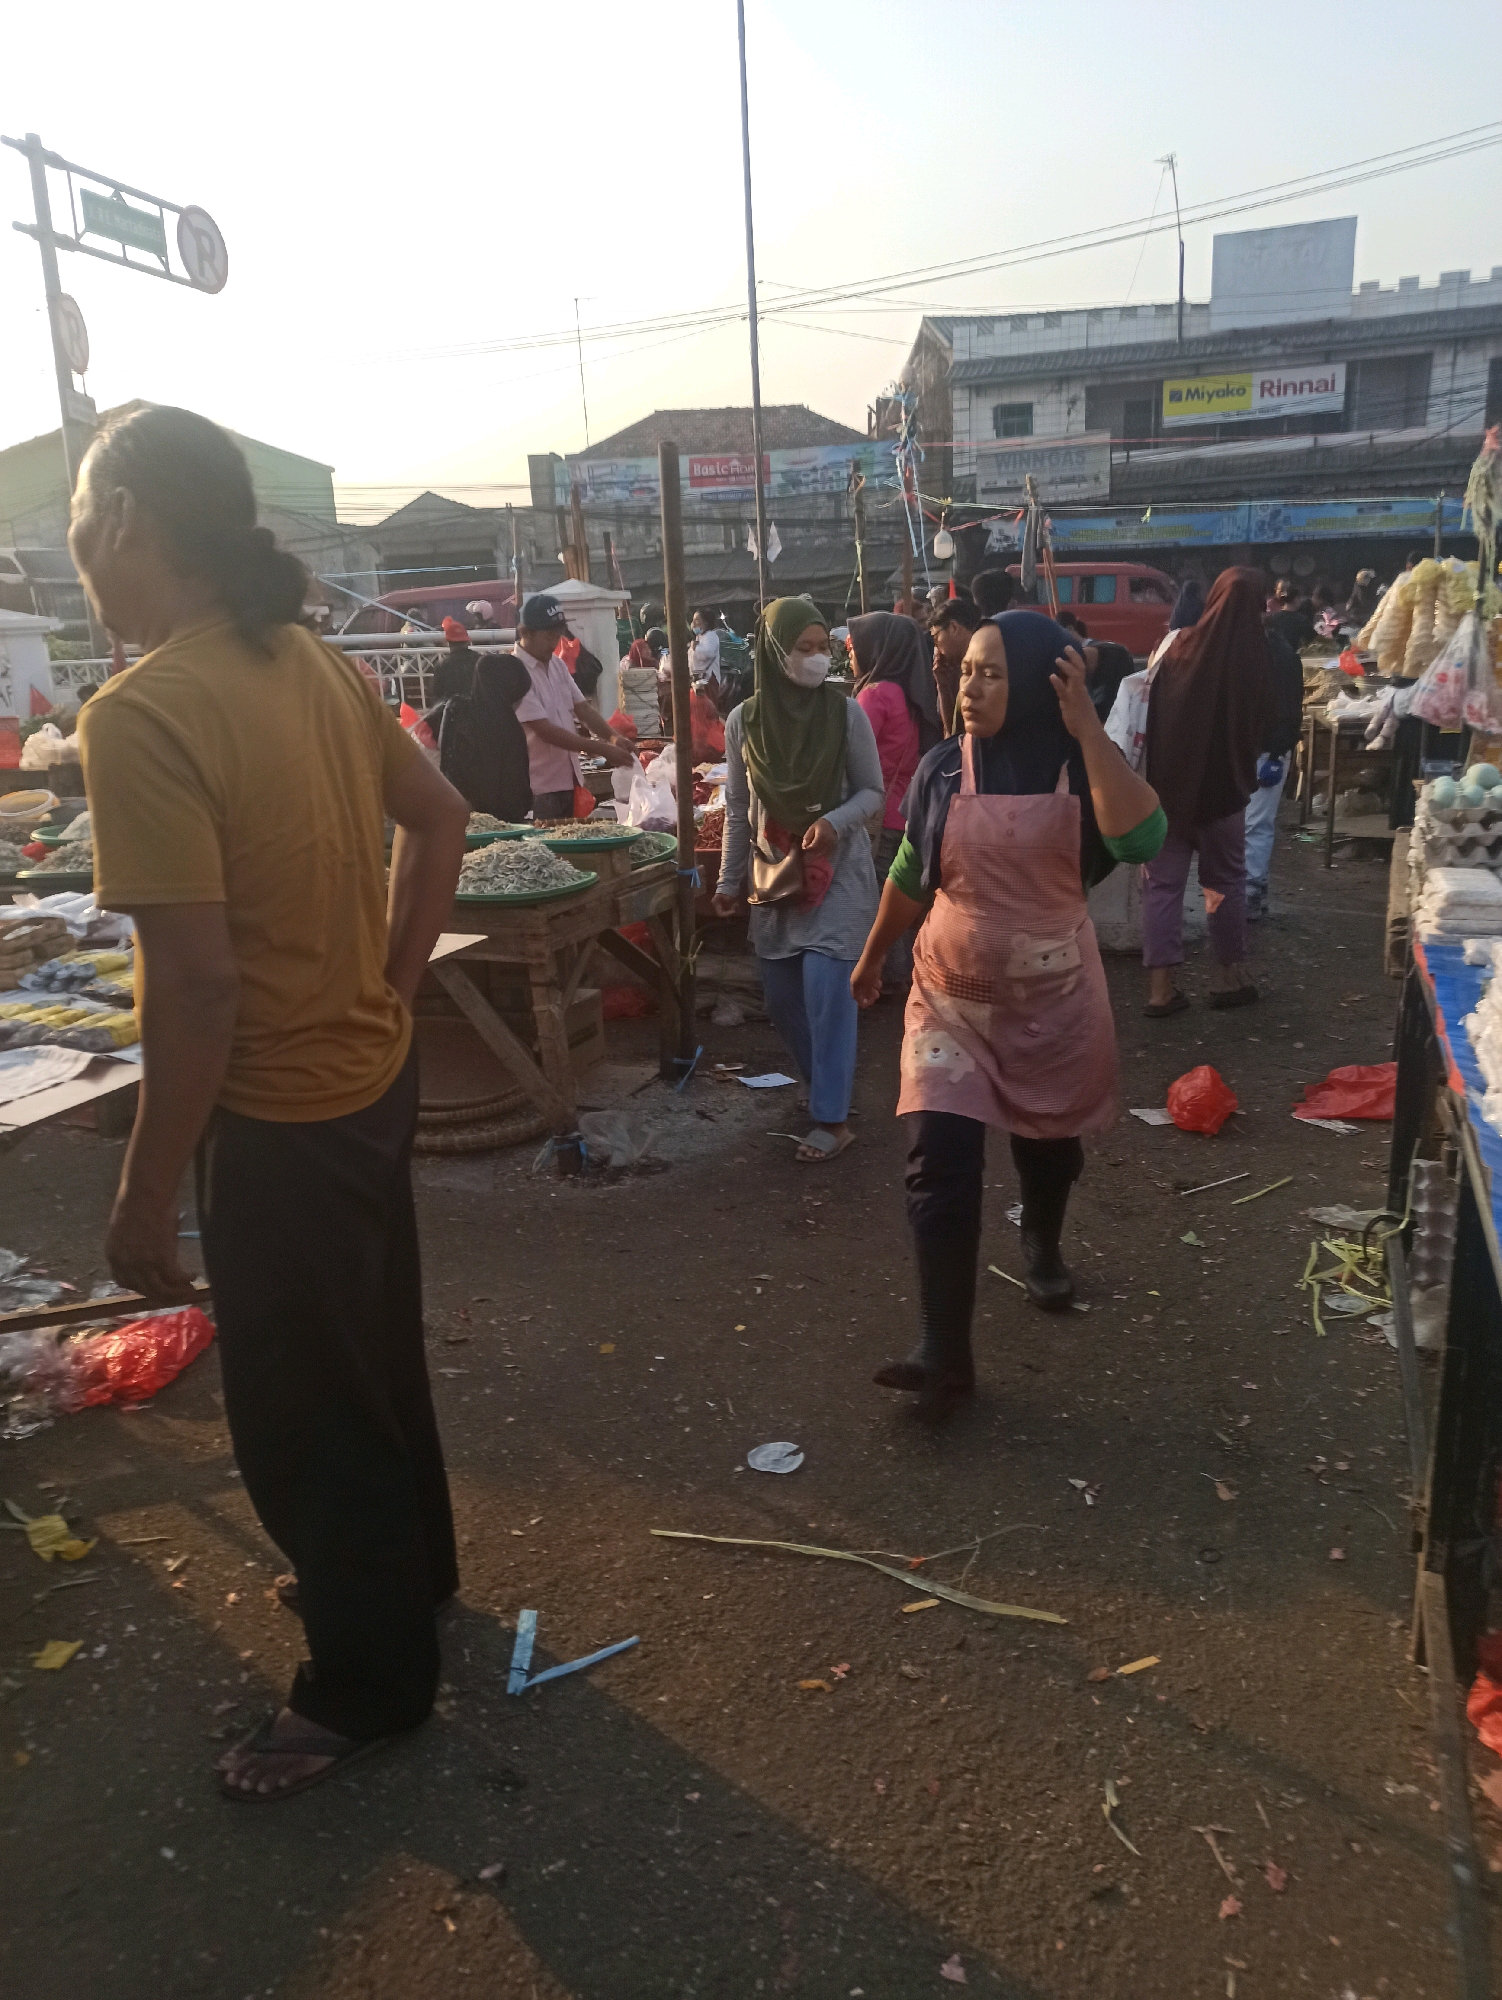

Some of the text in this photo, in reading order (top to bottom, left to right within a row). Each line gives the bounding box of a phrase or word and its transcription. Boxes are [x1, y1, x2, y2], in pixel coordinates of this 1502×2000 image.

[1185, 383, 1247, 404] Miyako
[1259, 372, 1336, 399] Rinnai
[693, 461, 729, 477] Basic
